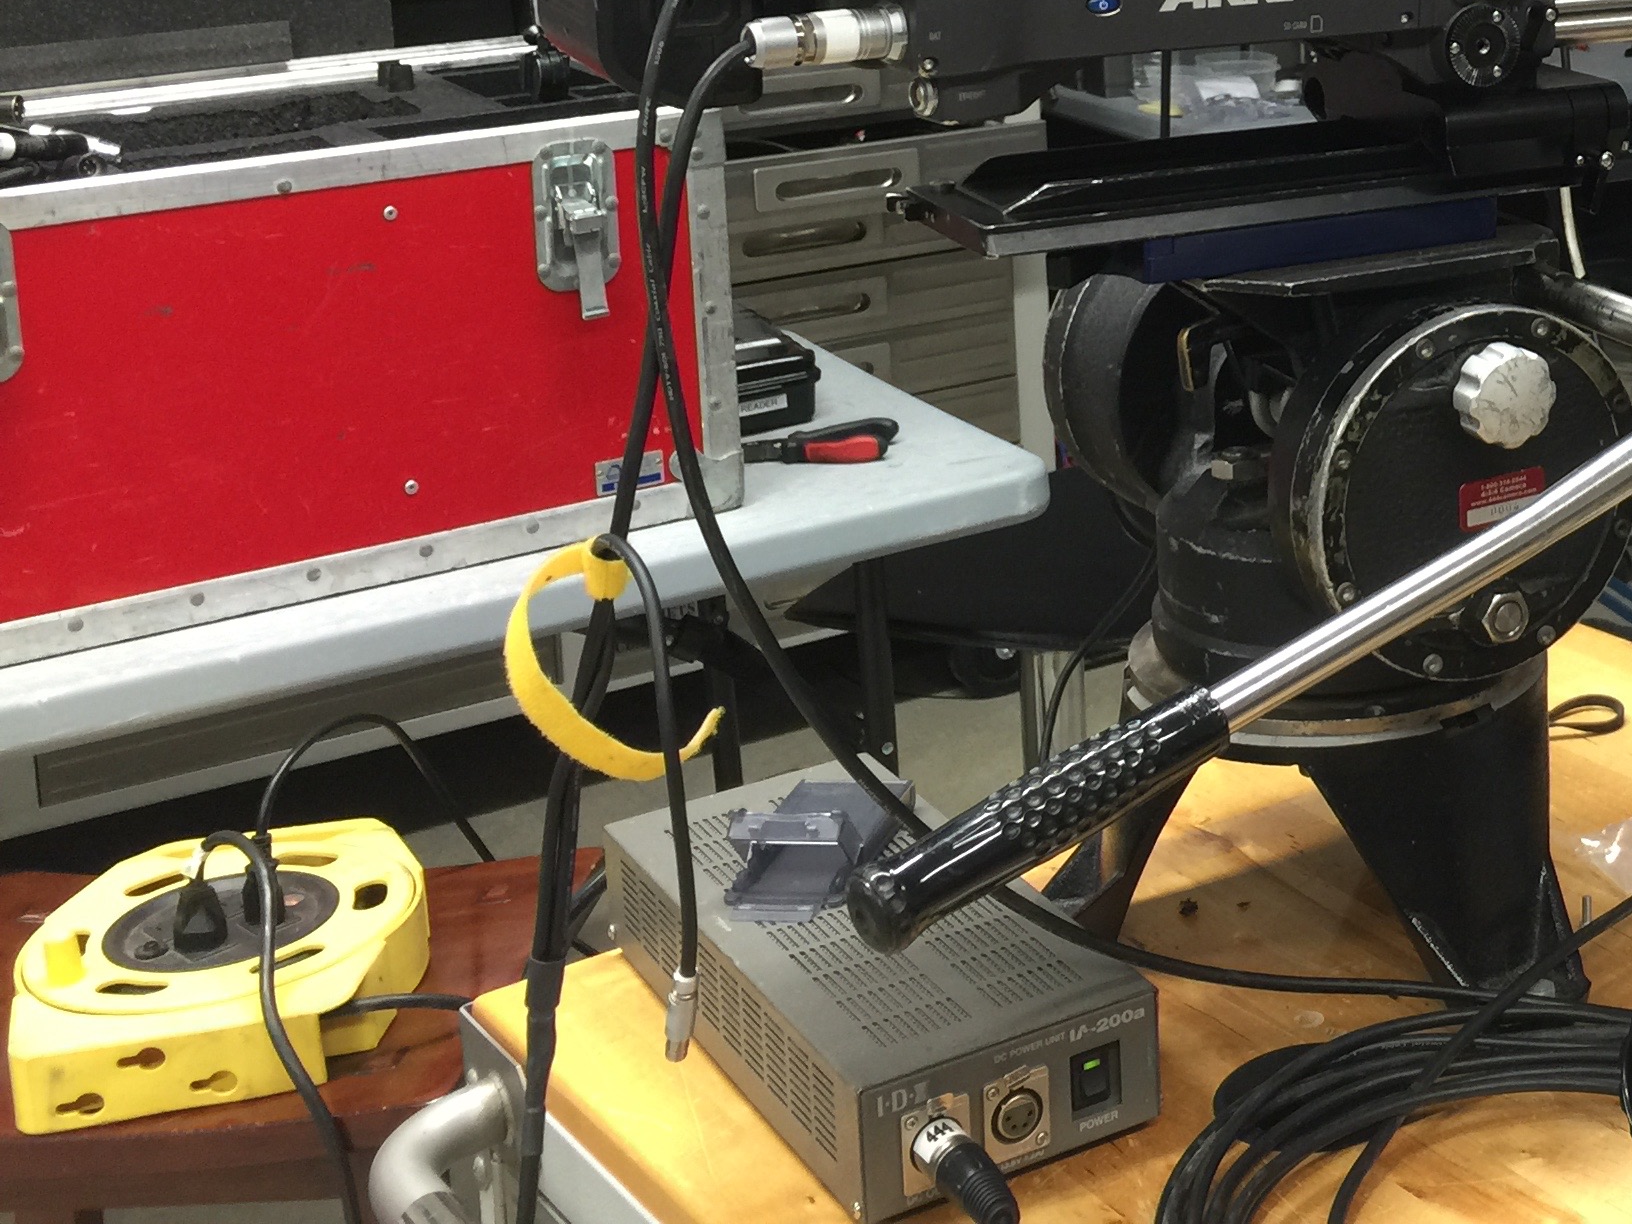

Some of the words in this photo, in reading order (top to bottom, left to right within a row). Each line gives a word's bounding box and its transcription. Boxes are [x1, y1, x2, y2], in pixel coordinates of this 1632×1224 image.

[993, 1051, 1006, 1065] DC
[1009, 1039, 1044, 1058] POWER
[1045, 1031, 1066, 1047] UNIT
[1078, 1110, 1119, 1133] POWER
